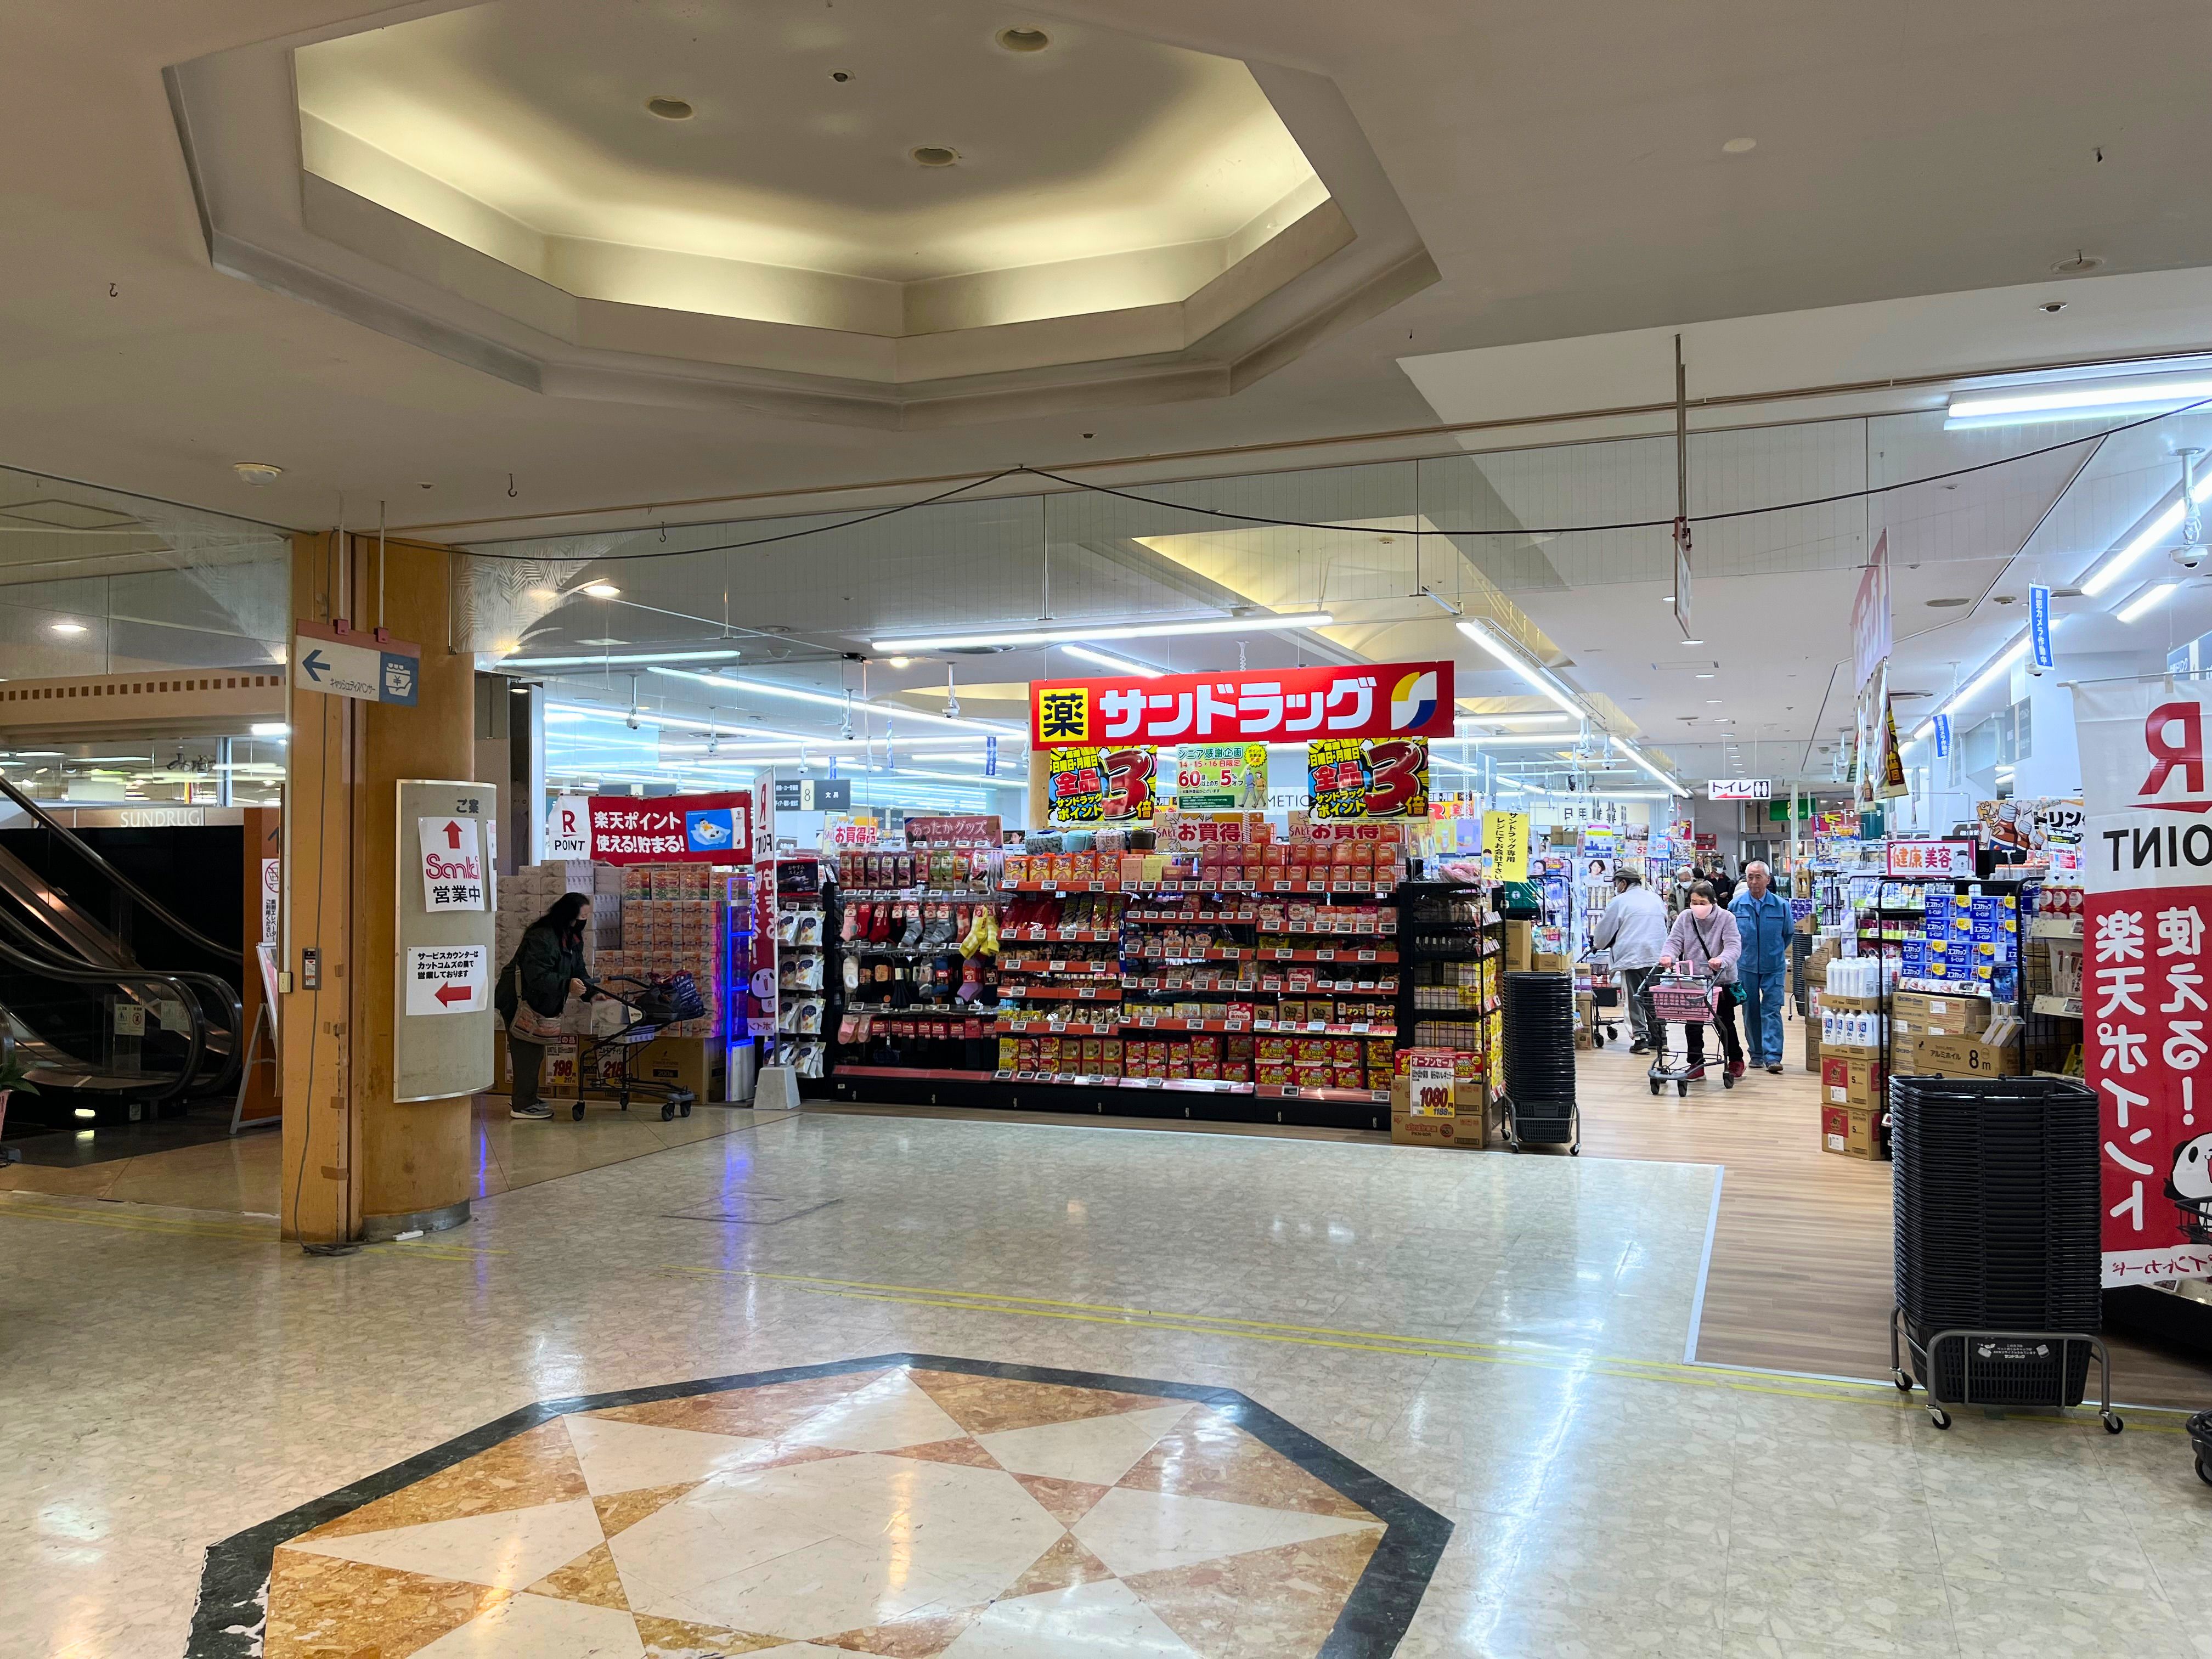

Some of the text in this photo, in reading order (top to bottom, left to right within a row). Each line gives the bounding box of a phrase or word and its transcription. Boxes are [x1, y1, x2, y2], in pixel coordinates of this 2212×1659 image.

[2035, 589, 2047, 665] 防犯カメラ作動中
[330, 678, 376, 693] キャッシュディスペンサー
[1043, 677, 1377, 738] 薬 サンドラッグ
[1178, 747, 1243, 759] シニア感謝企画
[1324, 742, 1340, 752] 毎週
[1056, 748, 1152, 819] 全品 3
[1179, 770, 1200, 787] 60
[1220, 770, 1232, 786] 5
[1313, 740, 1421, 816] 全品 3
[1713, 781, 1751, 792] トイレ
[804, 789, 810, 801] 8
[1057, 793, 1102, 807] サンドラッグ
[1316, 787, 1365, 804] サンドラッグ
[1058, 804, 1103, 821] ポイント
[1136, 801, 1152, 817] 倍
[1317, 799, 1366, 818] ポイント
[1404, 796, 1425, 814] 倍
[120, 810, 200, 827] SUNDRUG
[594, 811, 681, 831] 楽天ポイント
[2034, 811, 2085, 830] ドリン
[836, 826, 877, 843] お買得品
[912, 820, 988, 836] あったかグッズ
[1178, 823, 1243, 842] お買得
[555, 840, 585, 851] POINT
[596, 834, 685, 854] 使える!貯まる!
[1494, 817, 1505, 879] レジにてお会計下さい
[426, 854, 481, 879] Sanki
[433, 885, 481, 904] 営業中
[418, 951, 478, 960] サービスカウンターは
[418, 970, 469, 979] 営業しております
[1413, 1057, 1454, 1067] オープンセール
[1930, 1049, 1961, 1060] アルミホイル
[1969, 1049, 1991, 1070] 8 m
[553, 1060, 573, 1076] 198
[1420, 1086, 1448, 1108] 1080
